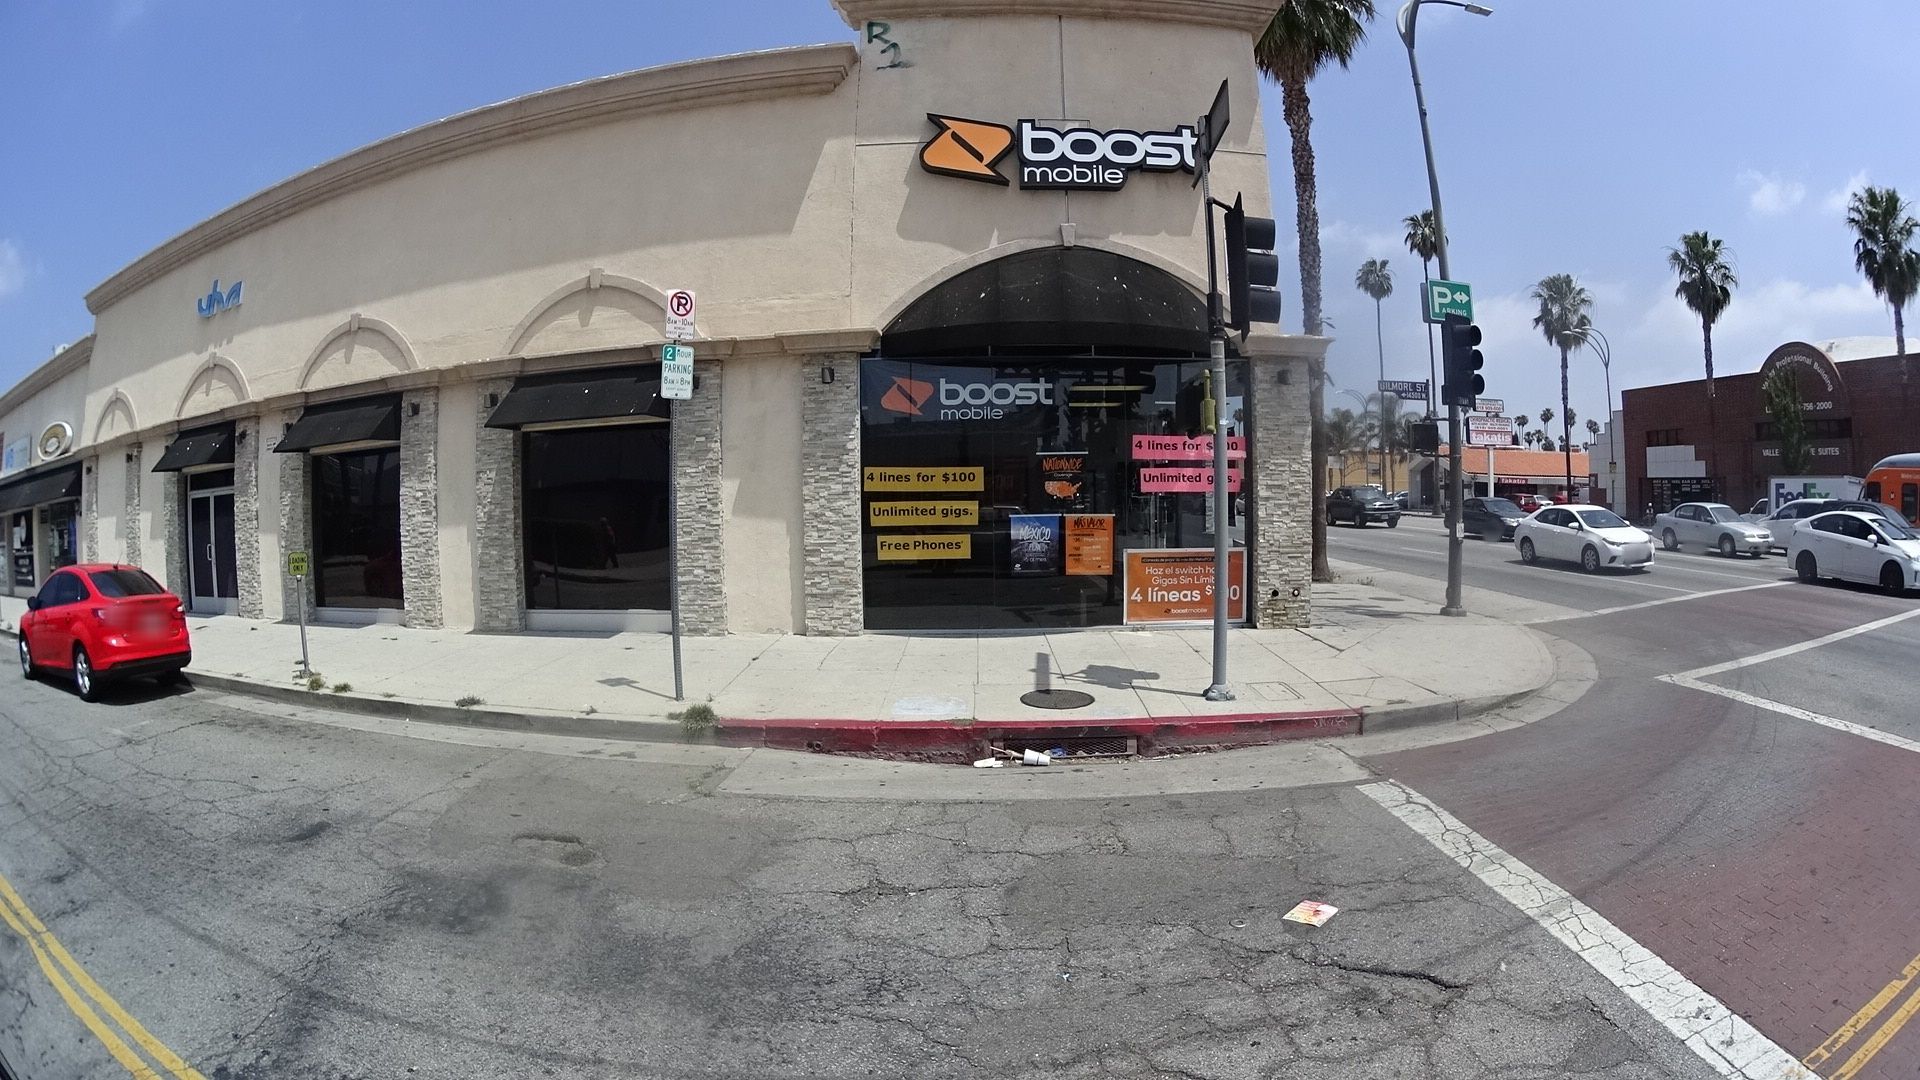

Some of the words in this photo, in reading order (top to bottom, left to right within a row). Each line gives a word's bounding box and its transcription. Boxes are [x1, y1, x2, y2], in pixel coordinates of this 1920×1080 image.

[867, 21, 890, 44] R
[1022, 122, 1197, 168] boost
[1024, 164, 1124, 184] mobile
[666, 348, 673, 359] 2
[677, 350, 691, 358] HOUR
[664, 363, 691, 375] PARKING
[1813, 362, 1834, 392] Building
[940, 377, 1053, 405] boost
[940, 407, 1003, 420] mobile
[1471, 431, 1511, 442] takatis
[1135, 441, 1143, 450] 4
[1147, 440, 1178, 450] lines
[1183, 441, 1201, 450] for
[1206, 441, 1238, 452] $0
[1818, 447, 1840, 456] SUITES
[1762, 448, 1782, 457] VALLE
[866, 472, 875, 482] 4
[880, 472, 911, 482] lines
[916, 472, 936, 482] for
[942, 471, 976, 484] $100
[1143, 473, 1201, 483] Unlimited
[1207, 474, 1236, 485] gs.
[1775, 483, 1830, 508] FedEx
[872, 506, 936, 516] Unlimited
[941, 506, 973, 518] gigs.
[880, 541, 910, 551] Free
[1145, 566, 1163, 575] Haz
[1165, 566, 1173, 575] el
[1175, 566, 1204, 574] switch
[1152, 576, 1178, 587] Gigas
[1179, 575, 1193, 584] Sin
[1130, 587, 1142, 602] 4
[1148, 587, 1201, 602] líneas
